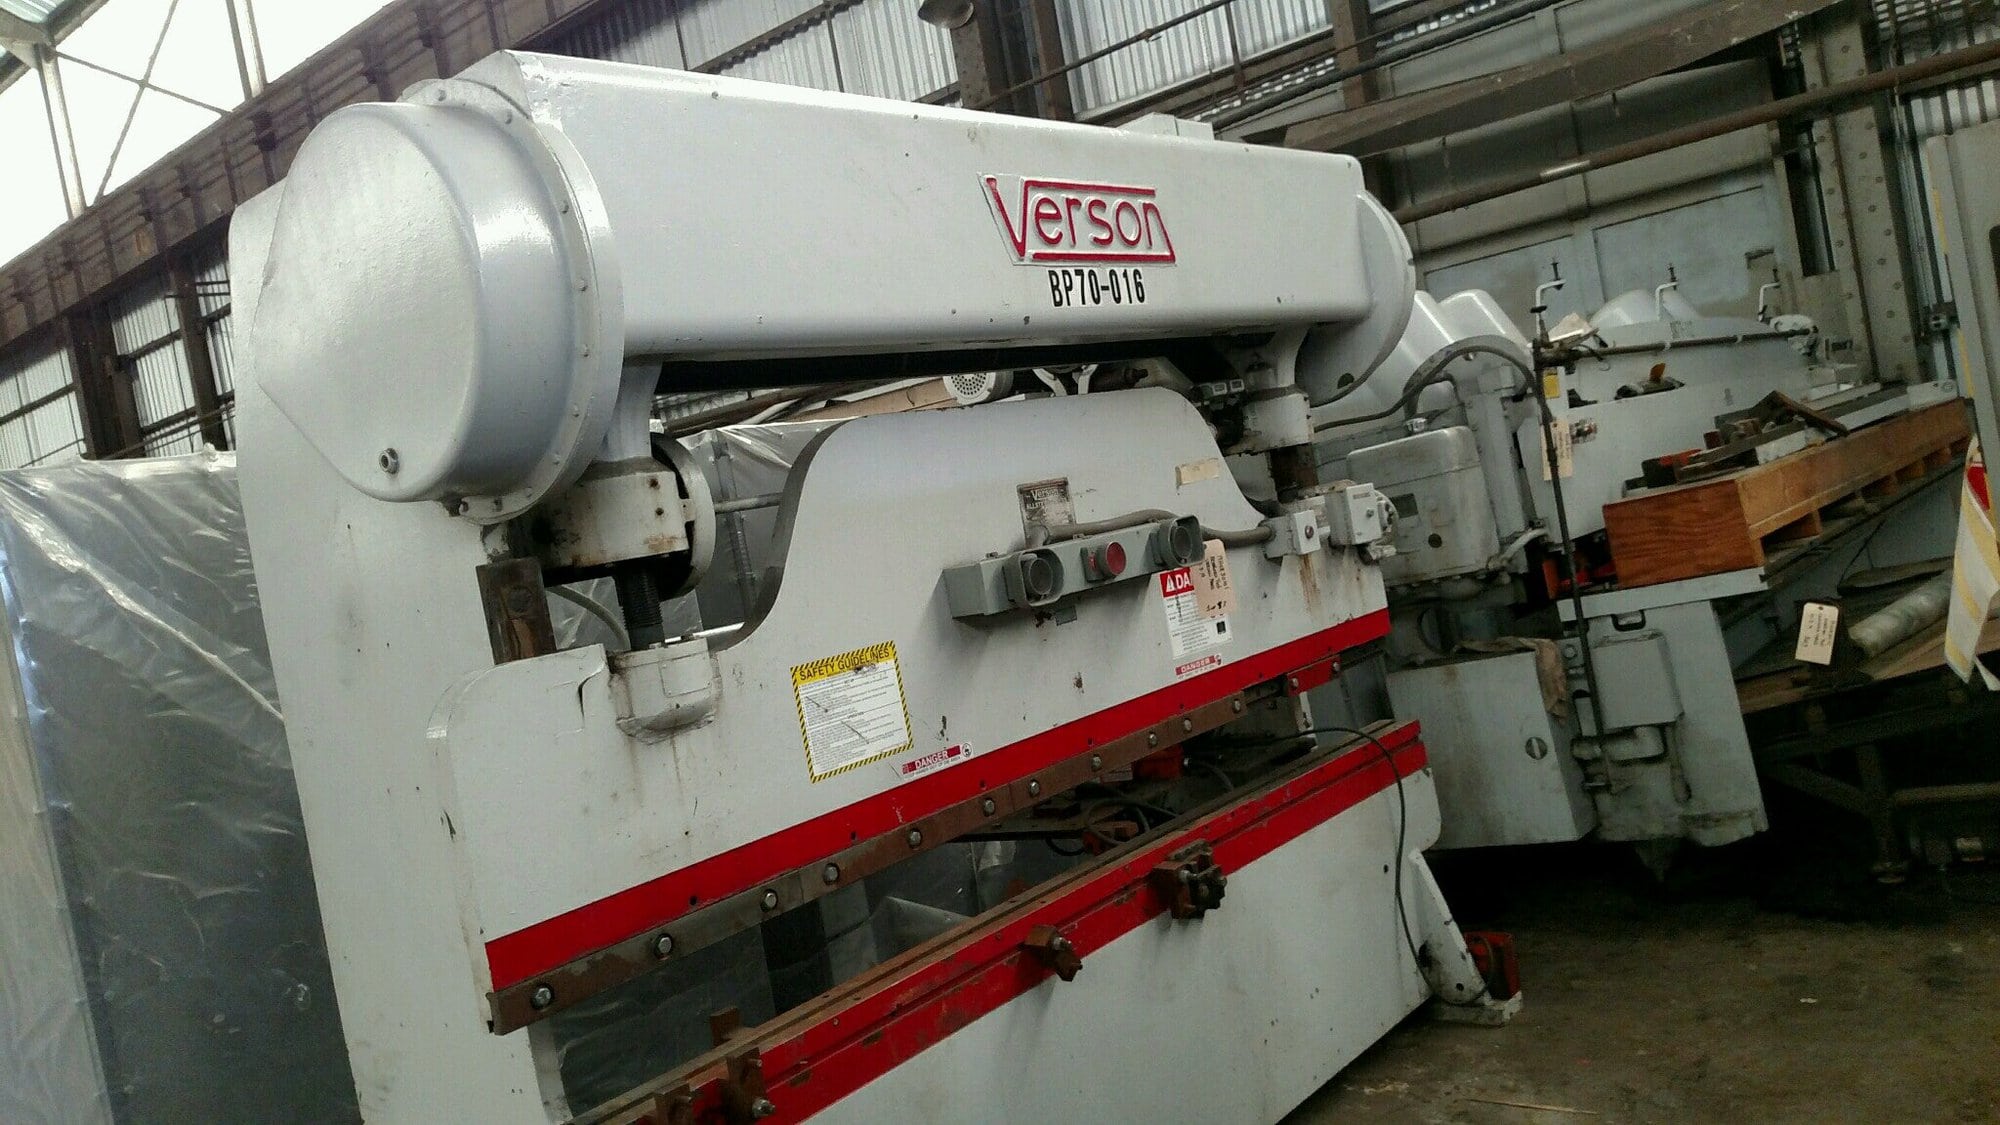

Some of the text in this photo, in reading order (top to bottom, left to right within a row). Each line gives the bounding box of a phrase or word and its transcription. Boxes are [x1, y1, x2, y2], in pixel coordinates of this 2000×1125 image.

[985, 176, 1176, 263] Verson
[1048, 269, 1146, 307] BP70-016
[800, 648, 890, 681] SAFETY GUIDELINES
[915, 750, 949, 769] DANGER
